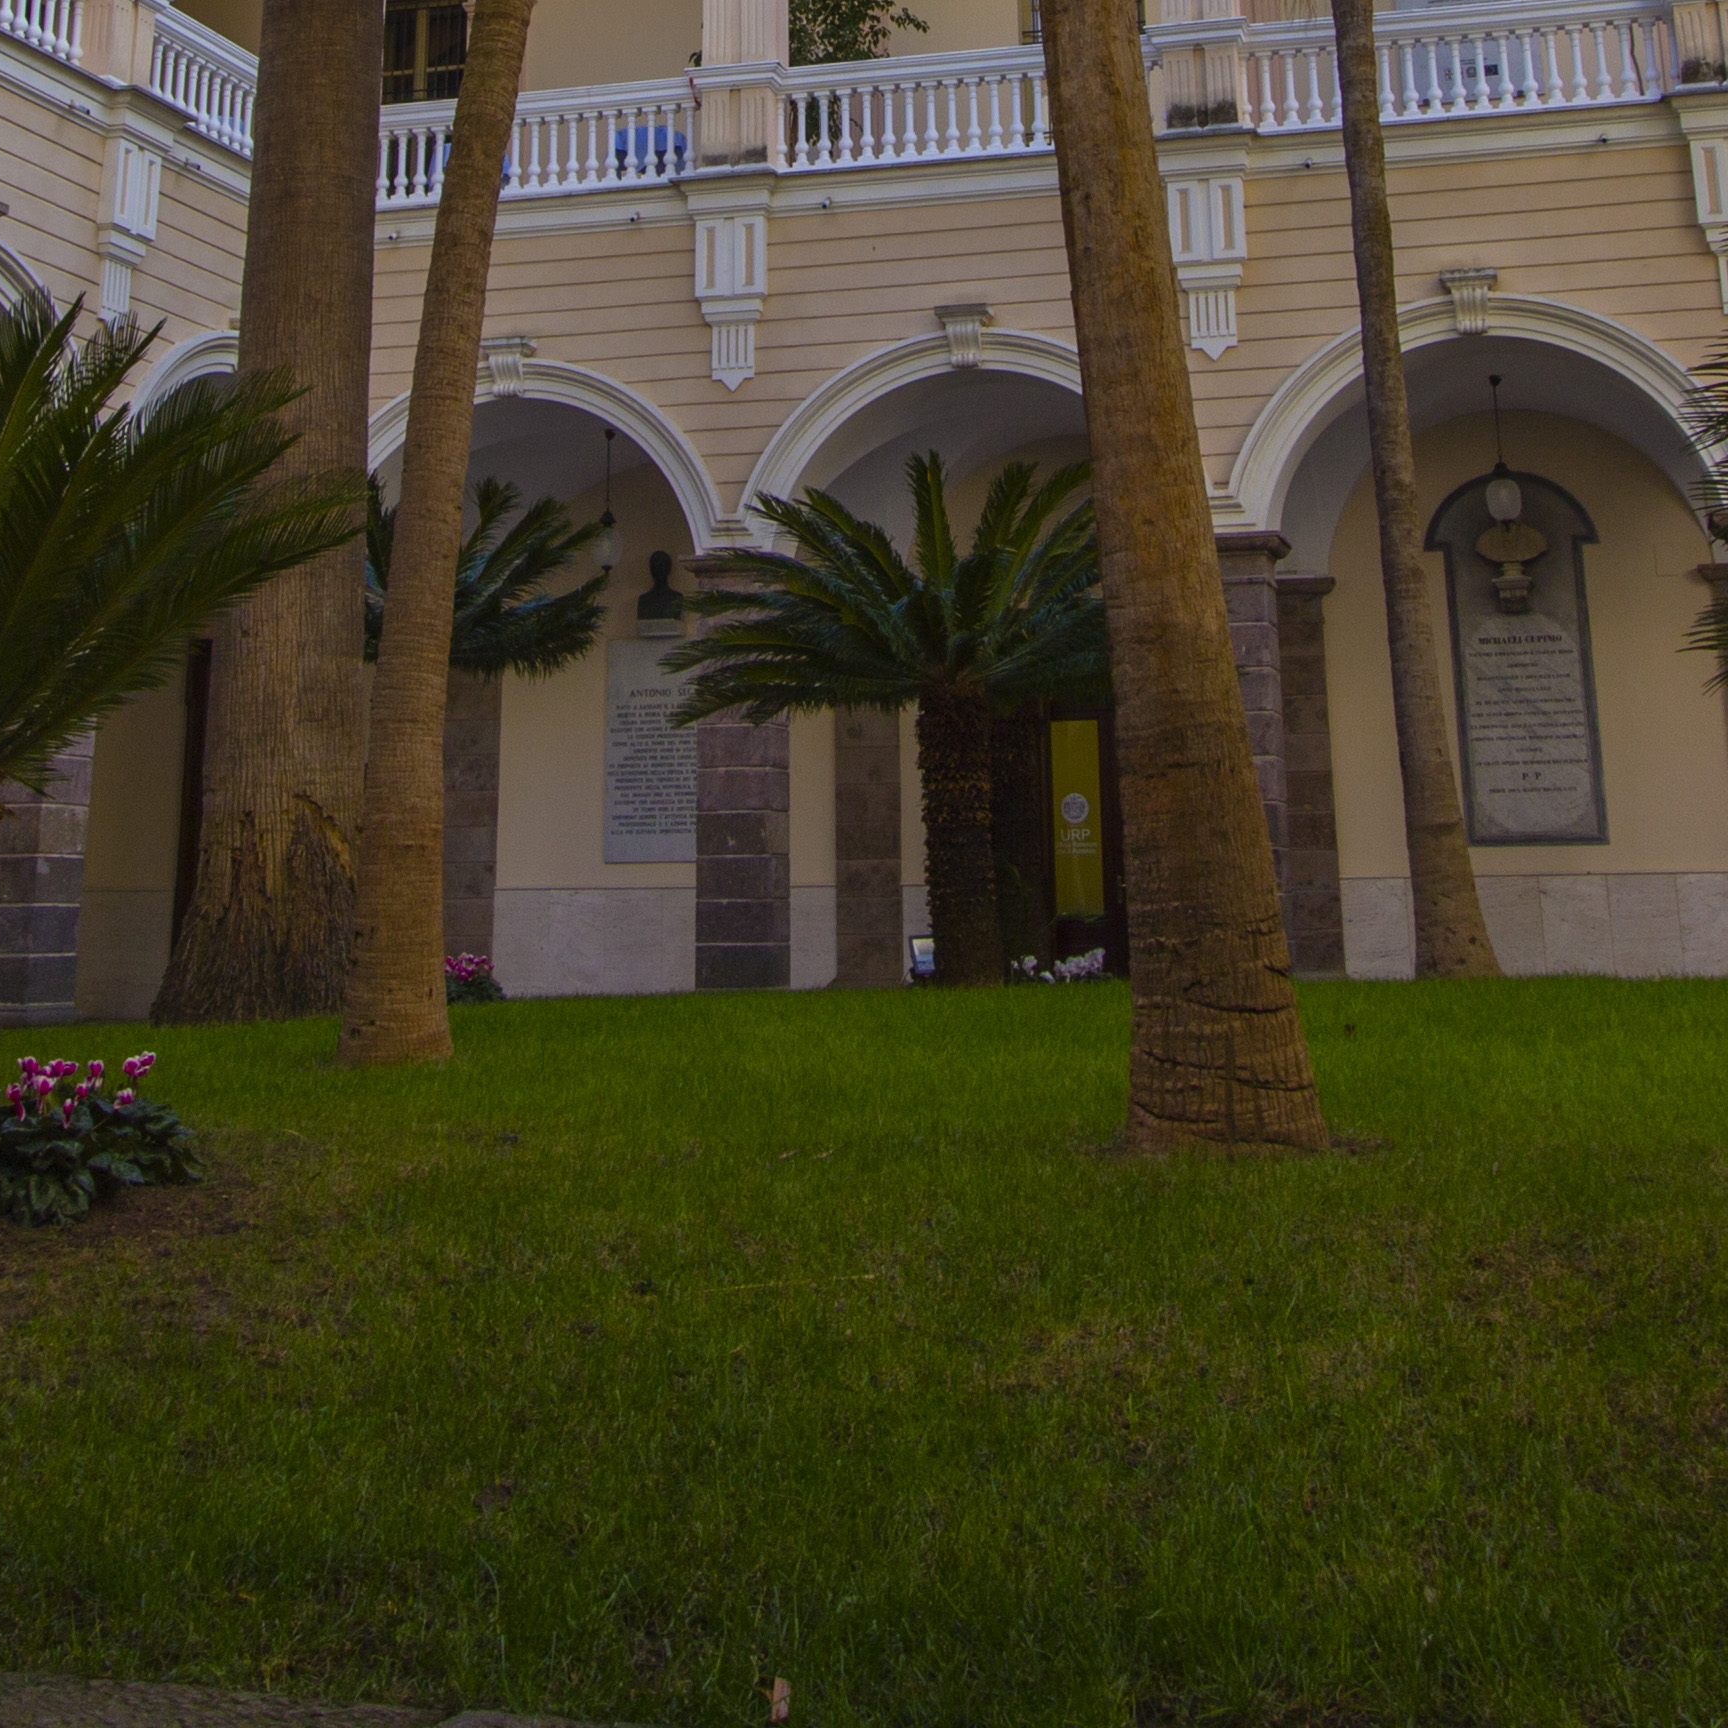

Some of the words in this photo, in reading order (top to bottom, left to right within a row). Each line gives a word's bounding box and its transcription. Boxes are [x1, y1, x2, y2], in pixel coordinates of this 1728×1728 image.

[630, 688, 671, 697] ANTONIO
[678, 688, 695, 696] SEG
[1060, 828, 1091, 842] URP
